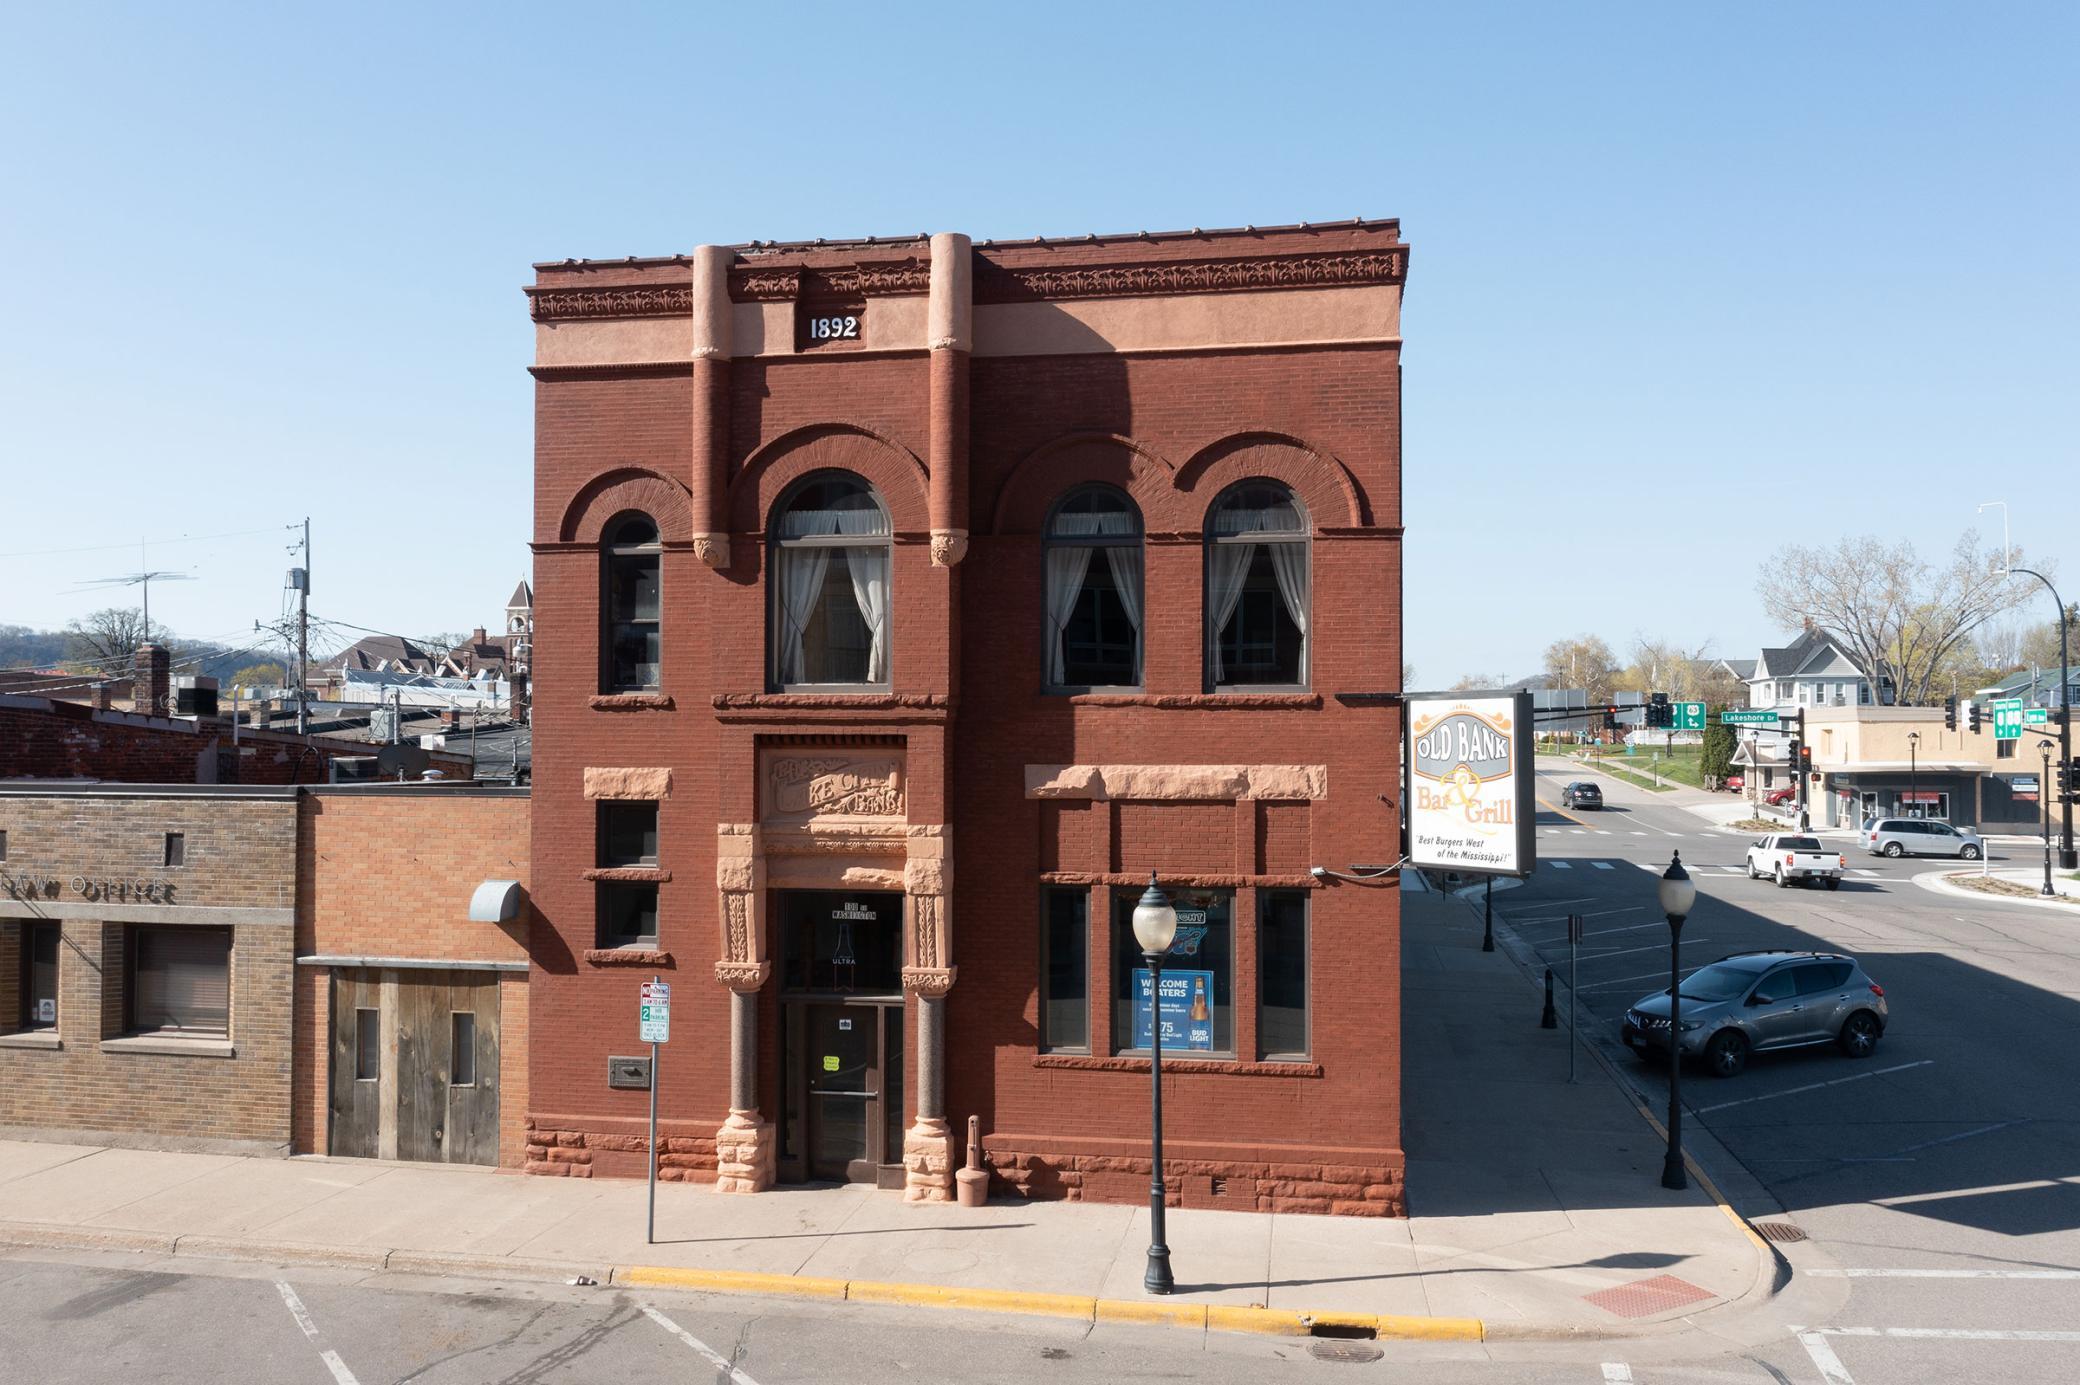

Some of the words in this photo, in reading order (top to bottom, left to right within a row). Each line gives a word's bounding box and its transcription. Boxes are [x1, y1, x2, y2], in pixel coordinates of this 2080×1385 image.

[811, 316, 857, 339] 1892
[1725, 713, 1764, 722] Lakeshore
[1416, 724, 1452, 762] OLD
[1457, 721, 1508, 762] BANK
[1416, 786, 1450, 810] Bar
[1465, 799, 1513, 825] Grill
[1436, 836, 1463, 848] Burgers
[1466, 838, 1484, 848] West
[1437, 849, 1446, 858] of
[1447, 850, 1459, 859] the
[1, 874, 49, 891] LAW
[70, 875, 165, 896] OFFICE
[832, 910, 876, 919] WASHINGTON
[642, 1008, 649, 1019] 2
